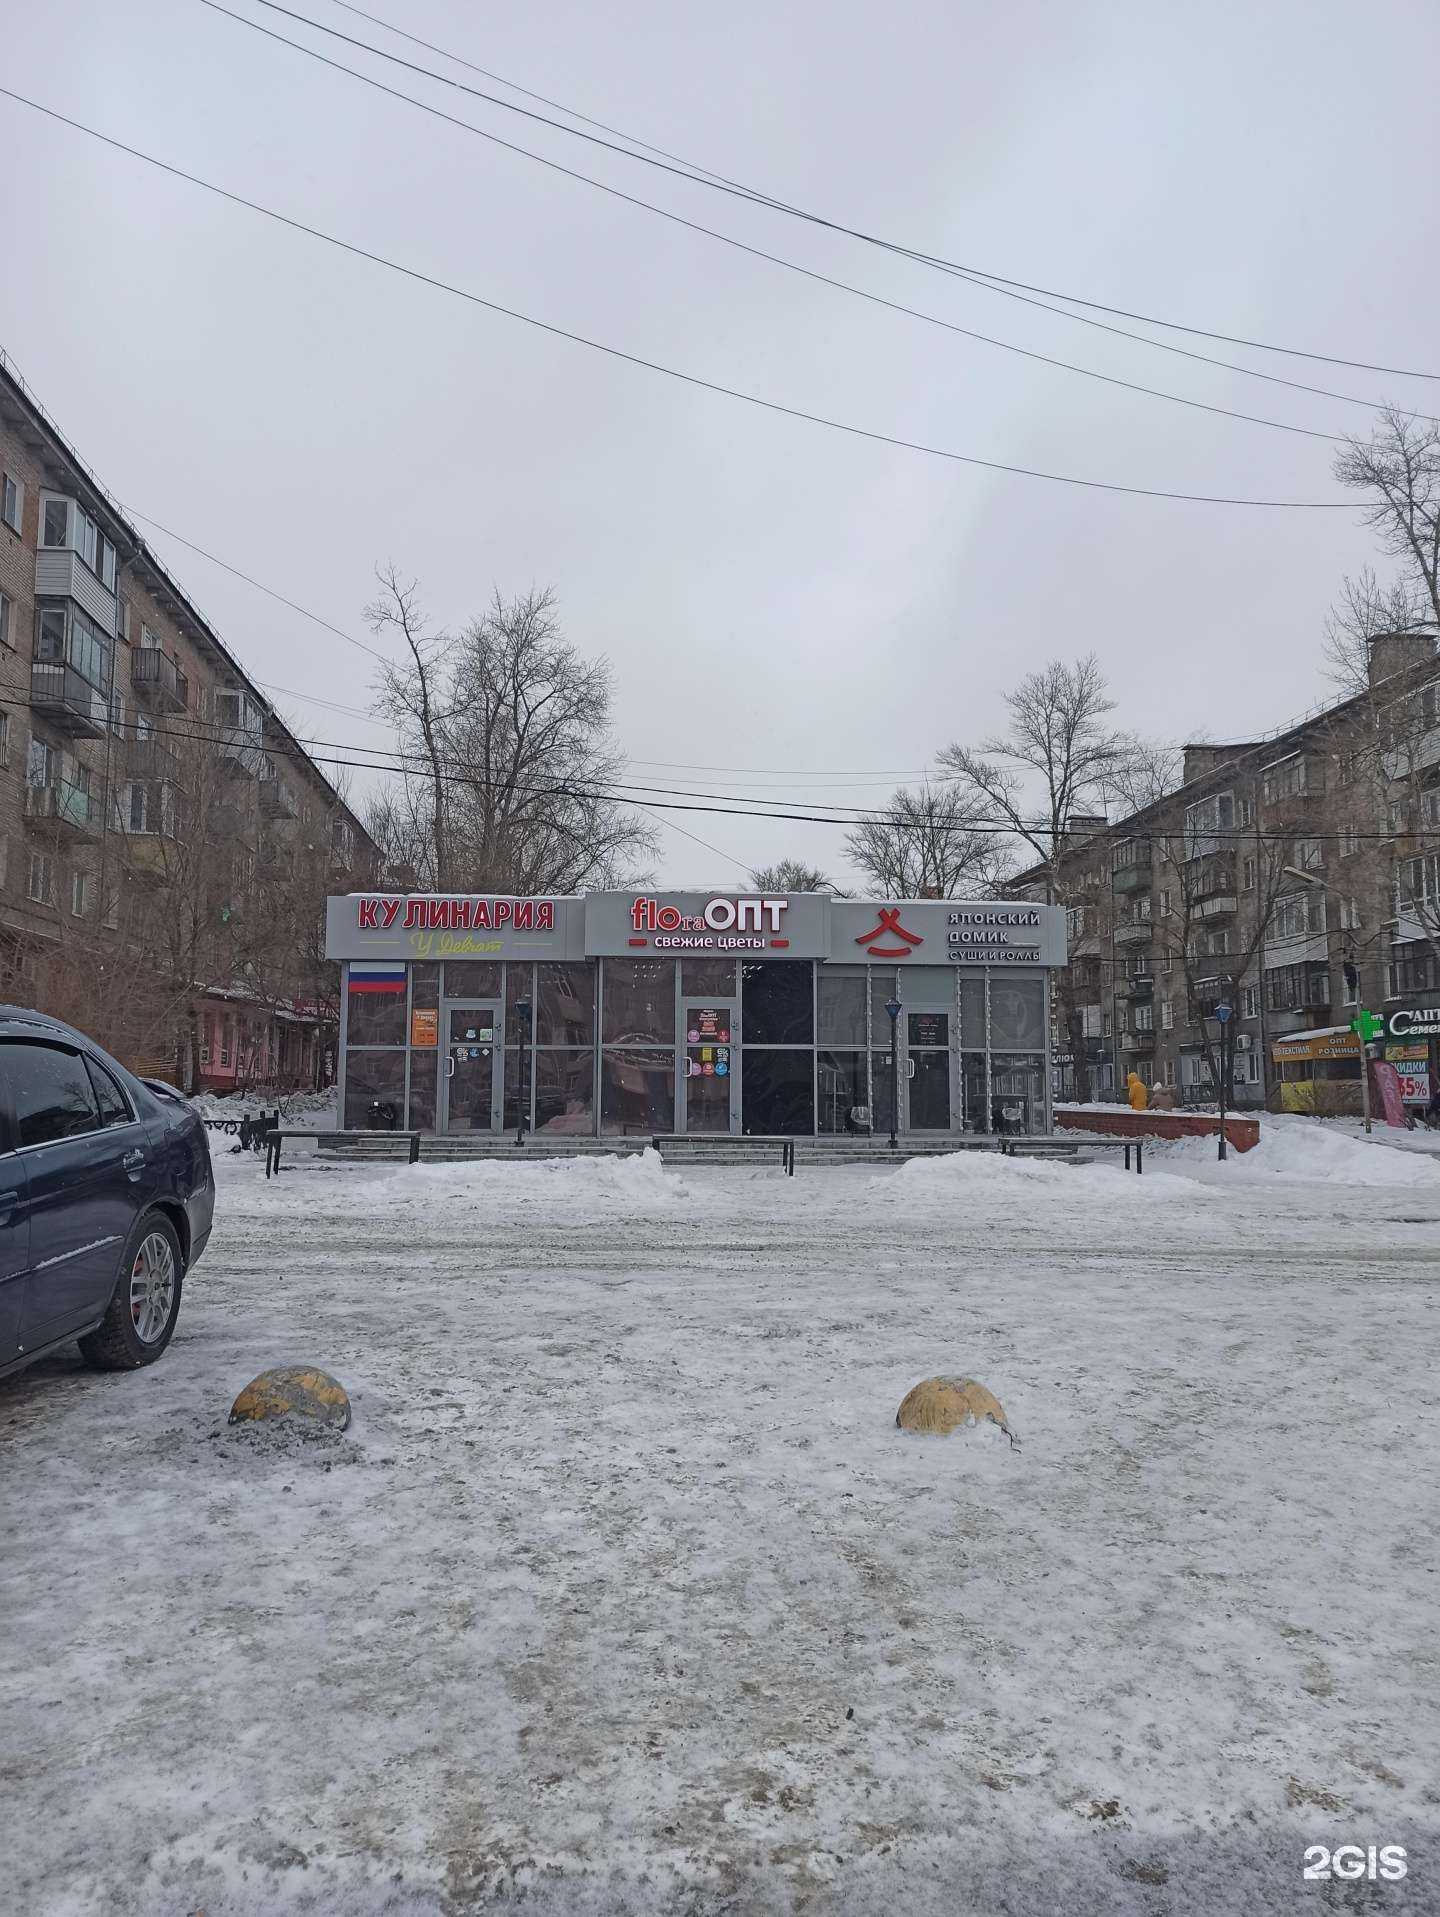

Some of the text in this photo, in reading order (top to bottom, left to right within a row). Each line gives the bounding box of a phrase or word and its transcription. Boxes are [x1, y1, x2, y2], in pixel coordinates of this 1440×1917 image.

[358, 898, 554, 930] КУЛИНАРИЯ
[949, 910, 1040, 925] ЯПОНСКИЙ
[654, 936, 766, 951] свежие цветы
[949, 931, 1009, 943] ДОМИК
[949, 951, 986, 961] СУШИ
[999, 951, 1041, 961] РОЛЛЫ
[1329, 1037, 1347, 1045] ОПТ
